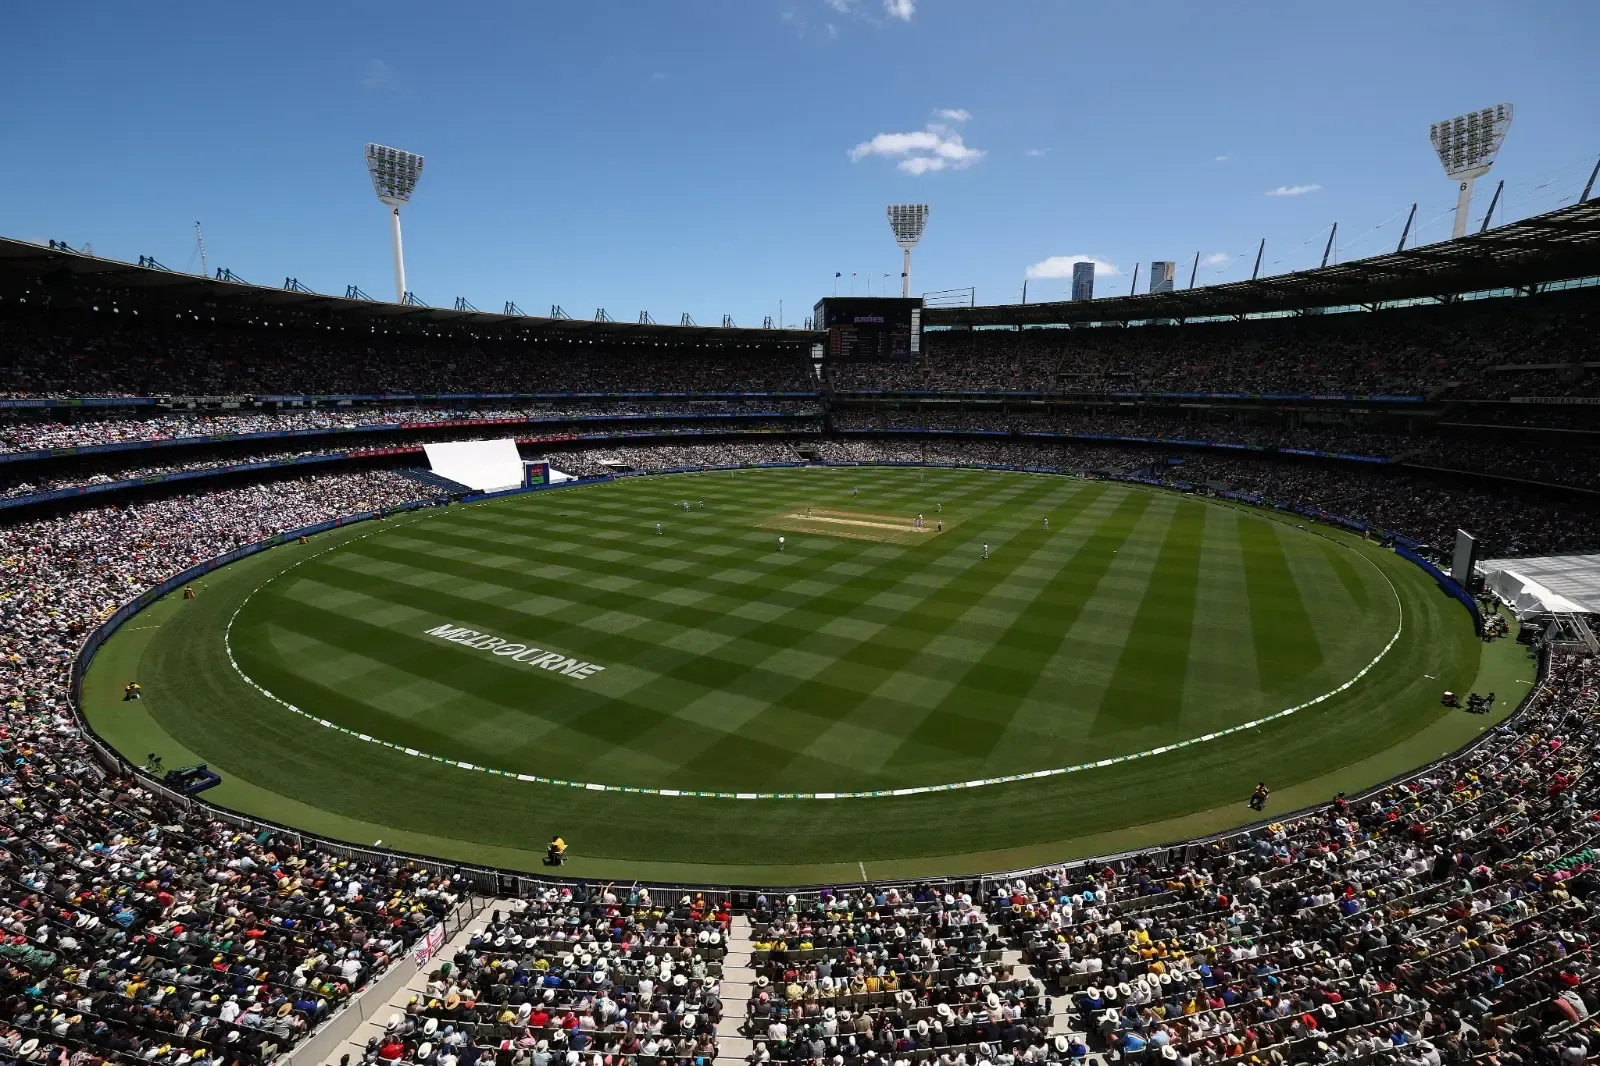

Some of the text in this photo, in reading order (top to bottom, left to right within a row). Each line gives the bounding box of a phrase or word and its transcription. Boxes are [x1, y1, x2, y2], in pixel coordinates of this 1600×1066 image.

[1459, 182, 1467, 191] 6
[393, 208, 399, 216] 4
[423, 623, 606, 680] MELBOURNE
